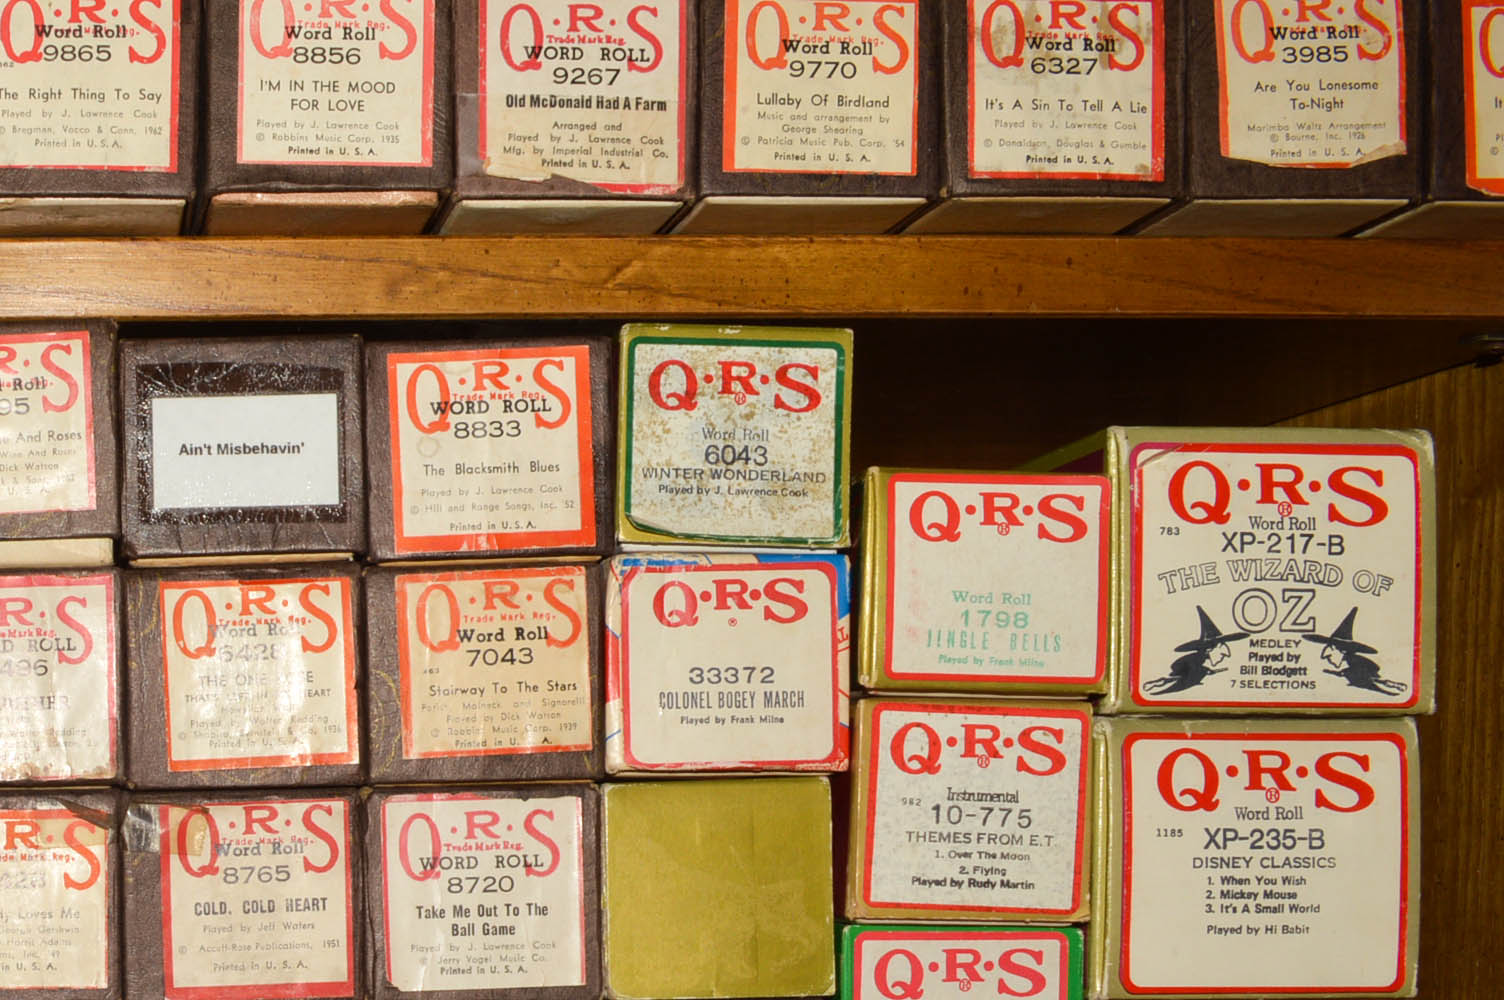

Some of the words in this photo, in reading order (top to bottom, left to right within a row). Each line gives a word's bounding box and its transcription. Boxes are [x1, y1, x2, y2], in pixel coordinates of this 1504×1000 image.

[44, 45, 111, 62] 9865
[293, 47, 360, 65] 8856
[1283, 46, 1348, 63] 3985
[790, 60, 856, 79] 9770
[1031, 57, 1097, 75] 6327
[553, 67, 620, 85] 9267
[757, 93, 801, 109] Lullaby
[811, 94, 828, 106] Of
[837, 95, 889, 108] Birdland
[454, 420, 521, 439] 8833
[179, 444, 211, 455] Ain't
[217, 442, 304, 455] Misbehavin'
[705, 445, 767, 466] 6043
[642, 468, 704, 480] WINTER
[710, 468, 826, 484] WONDERLAND
[659, 484, 693, 496] Played
[697, 485, 710, 496] by
[727, 486, 778, 496] Lawrence
[781, 488, 808, 498] Cook
[1160, 527, 1180, 535] 783
[1222, 532, 1344, 555] XP-217-B
[1158, 562, 1220, 594] THE
[1226, 558, 1343, 587] WIZARD
[1352, 570, 1394, 597] OF
[962, 609, 1029, 629] 1798
[1232, 588, 1315, 633] OZ
[1249, 639, 1301, 648] MEDLEY
[466, 648, 533, 666] 7043
[1249, 652, 1284, 664] Played
[1287, 652, 1301, 664] by
[689, 667, 774, 684] 33372
[1240, 680, 1316, 689] SELECTIONS
[659, 691, 712, 709] COLONEL
[718, 691, 755, 709] BOGEY
[764, 691, 804, 708] MARCH
[947, 787, 1019, 803] Instrumental
[932, 804, 1032, 829] 10-775
[906, 831, 972, 844] THEMES
[977, 833, 1023, 845] FROM
[1157, 828, 1183, 837] 1185
[1204, 828, 1325, 850] XP-235-B
[1193, 856, 1253, 869] DISNEY
[1260, 857, 1336, 869] CLASSICS
[223, 865, 290, 884] 8765
[1220, 876, 1250, 885] When
[1256, 876, 1277, 885] You
[1281, 876, 1306, 886] Wish
[448, 876, 514, 893] 8720
